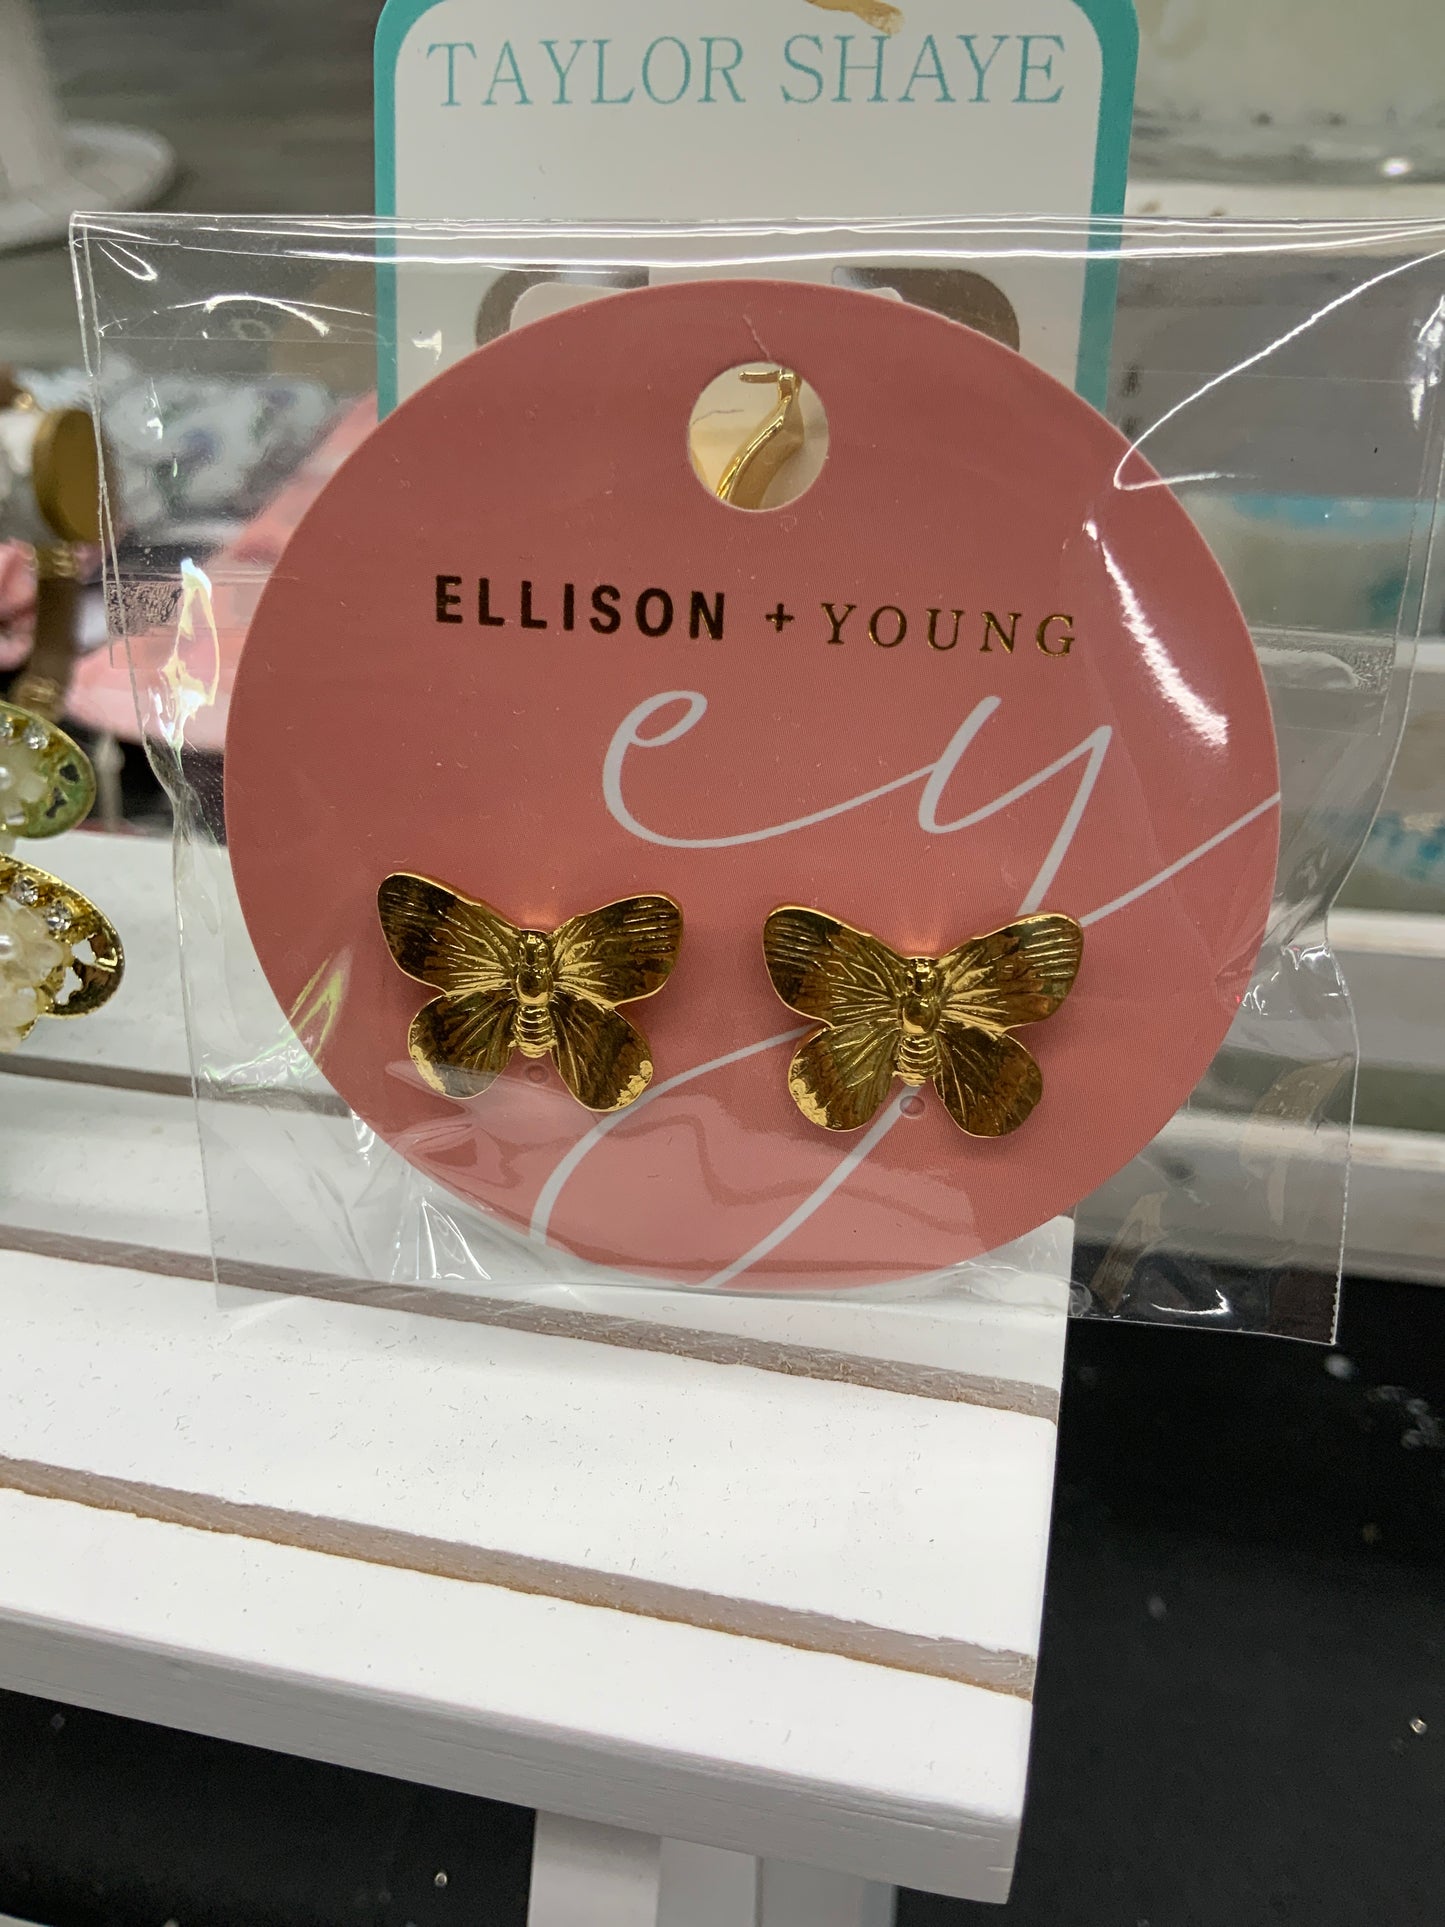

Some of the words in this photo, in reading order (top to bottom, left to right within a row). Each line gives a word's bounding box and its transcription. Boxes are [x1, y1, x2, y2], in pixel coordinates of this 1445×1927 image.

[426, 36, 748, 107] TAYLOR
[779, 33, 1066, 104] SHAYE
[434, 574, 727, 641] ELLISON
[764, 602, 795, 634] +
[820, 601, 1077, 659] YOUNG
